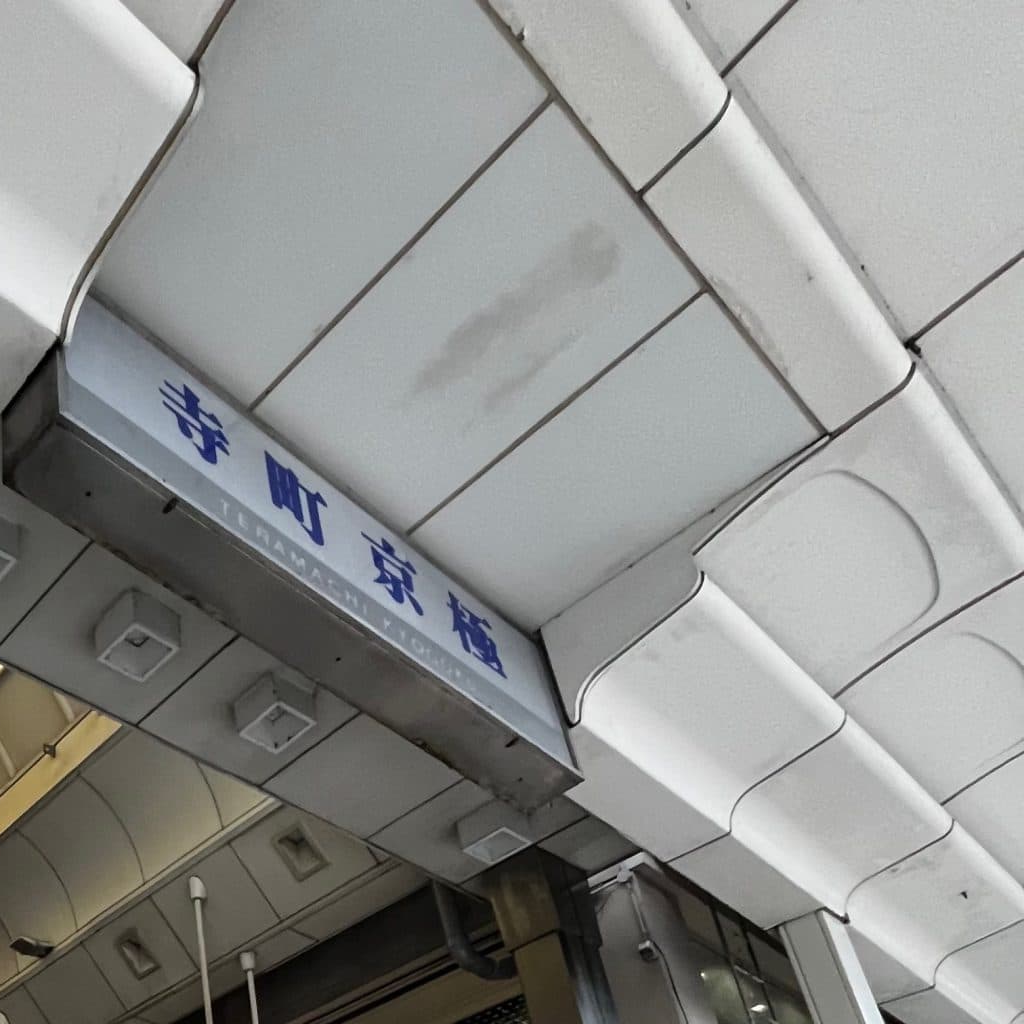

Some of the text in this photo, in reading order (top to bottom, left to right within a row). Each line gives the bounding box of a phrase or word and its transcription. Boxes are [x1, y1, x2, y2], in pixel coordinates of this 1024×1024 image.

[158, 379, 508, 679] 寺町京極
[220, 499, 372, 616] TERAMACHI
